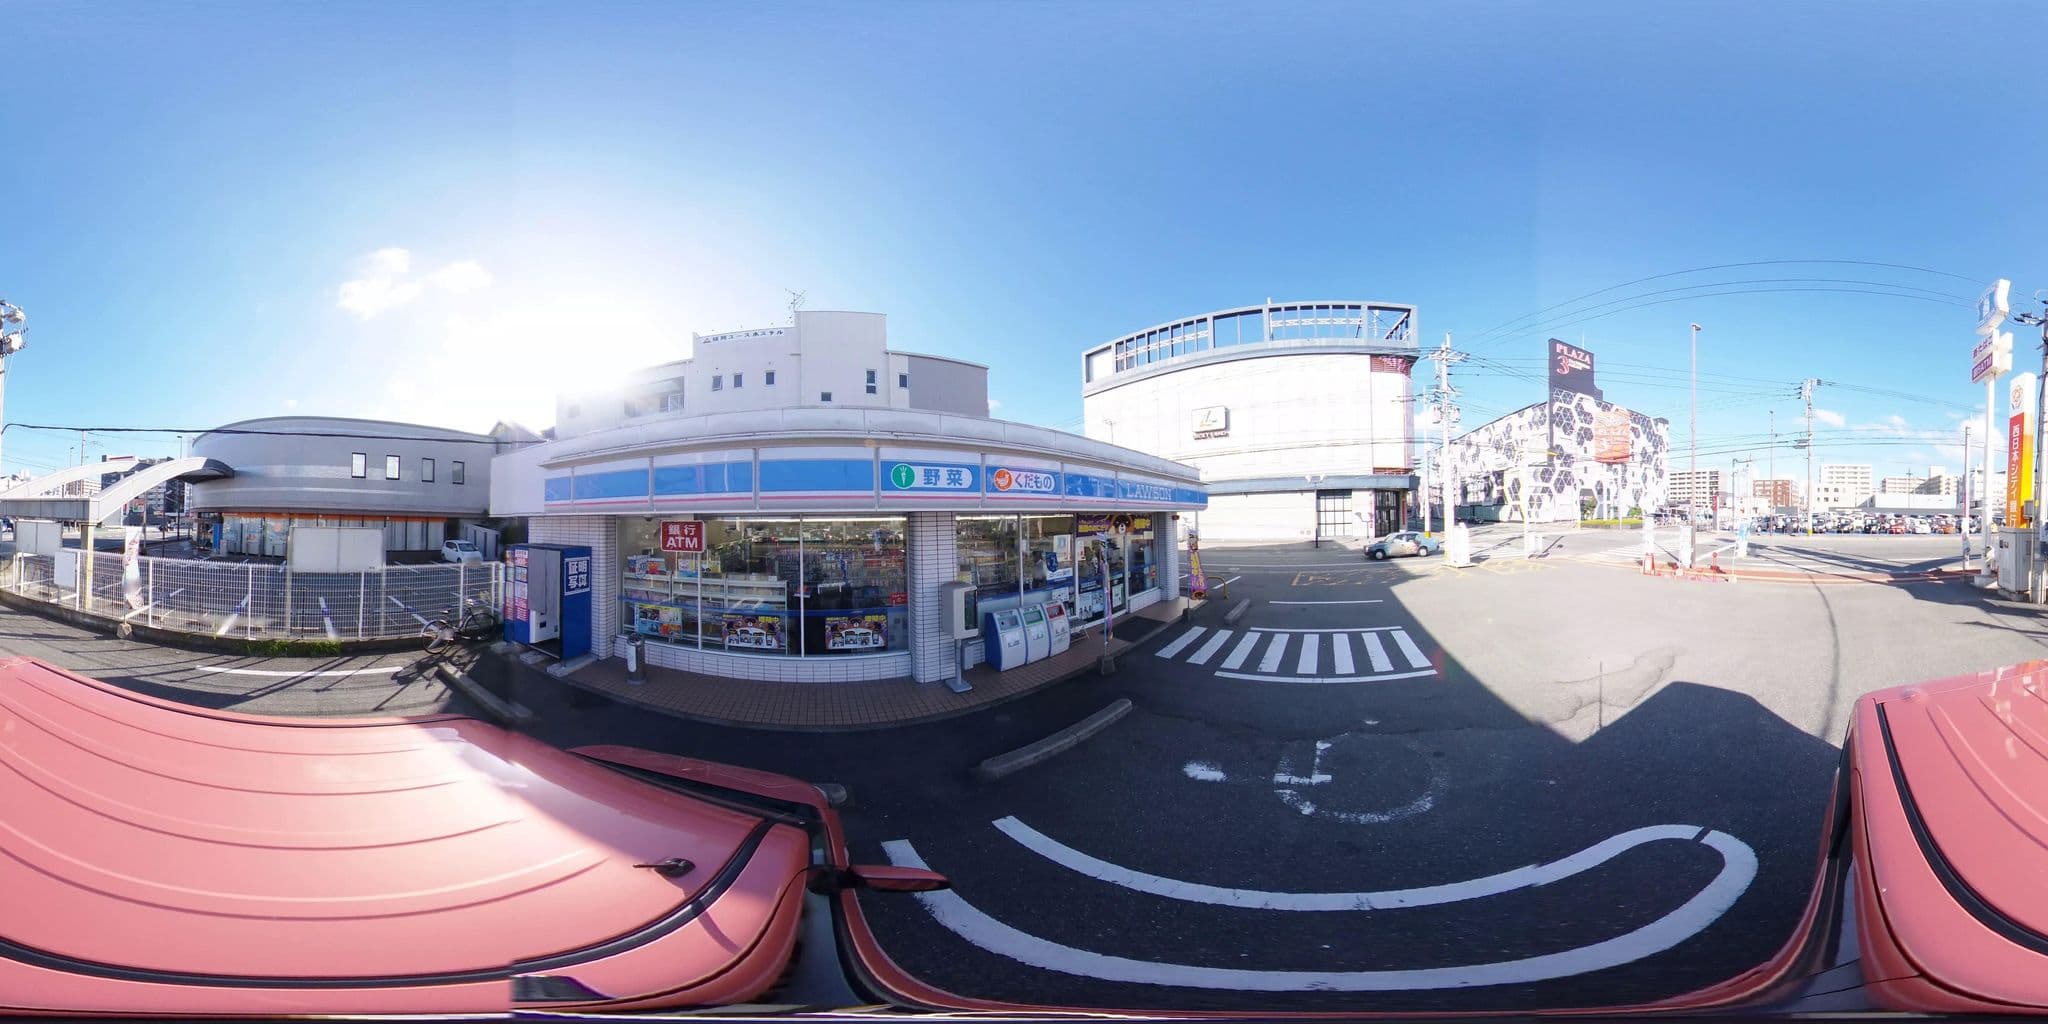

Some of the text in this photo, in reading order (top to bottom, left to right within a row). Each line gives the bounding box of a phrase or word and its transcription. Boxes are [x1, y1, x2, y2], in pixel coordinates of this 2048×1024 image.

[1556, 343, 1591, 364] PLAZA
[923, 468, 963, 487] 野菜
[1014, 473, 1053, 490] くだもの
[1126, 482, 1172, 501] LAWSON
[668, 523, 697, 536] 銀行
[666, 536, 698, 549] ATM
